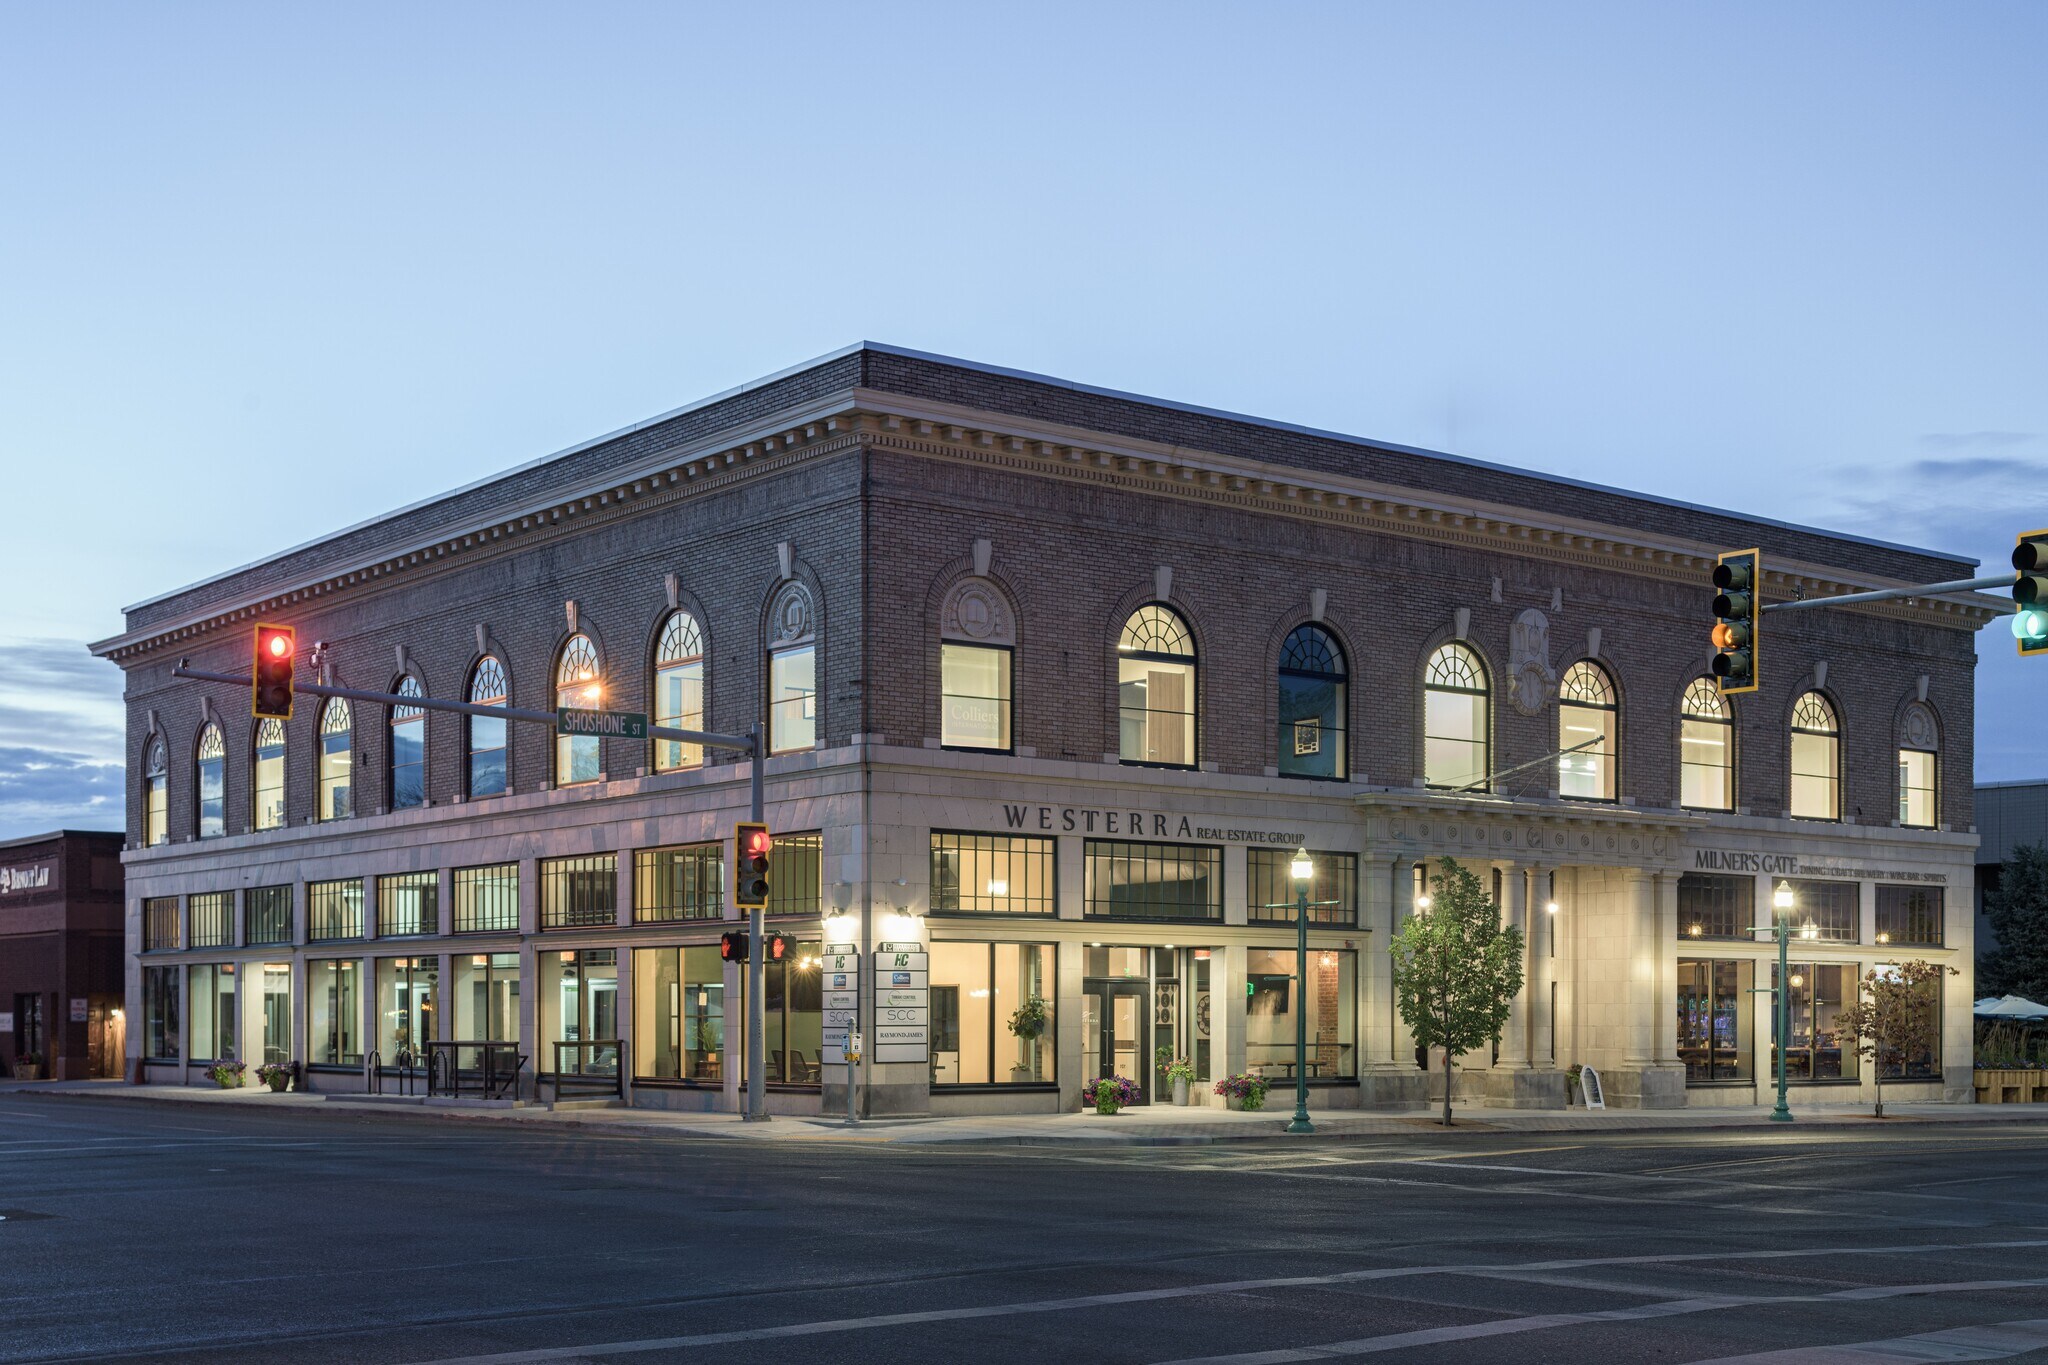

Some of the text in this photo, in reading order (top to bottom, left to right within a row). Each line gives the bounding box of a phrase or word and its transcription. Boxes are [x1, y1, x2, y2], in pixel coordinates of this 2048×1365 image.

[565, 711, 641, 735] SHOSHONE ST
[952, 704, 998, 723] Colliers
[1002, 804, 1306, 845] WESTERRA REAL ESTATE GROUP
[1695, 850, 1760, 872] MILNER'S
[1762, 855, 1798, 874] GATE
[1800, 864, 1826, 876] DINING
[829, 1011, 849, 1022] SCC
[887, 1009, 916, 1020] SCC
